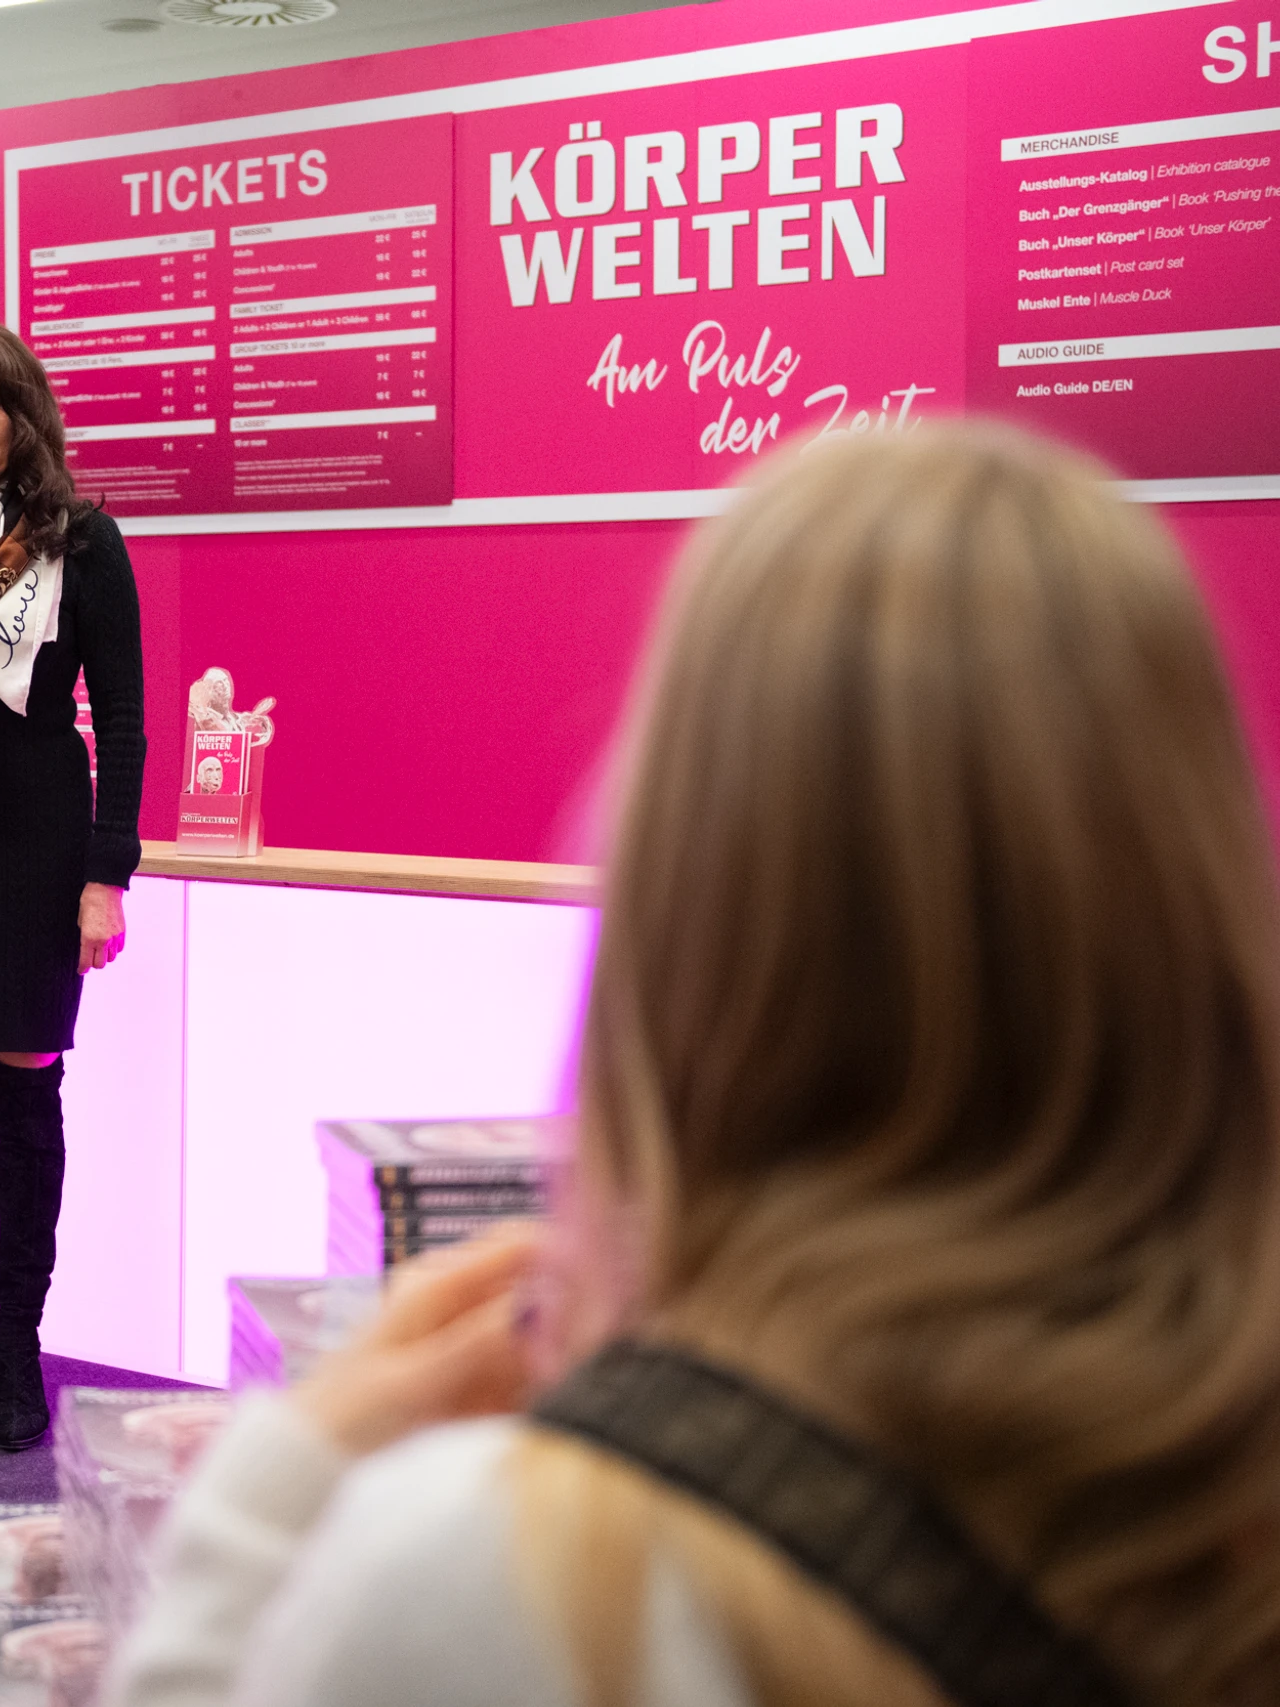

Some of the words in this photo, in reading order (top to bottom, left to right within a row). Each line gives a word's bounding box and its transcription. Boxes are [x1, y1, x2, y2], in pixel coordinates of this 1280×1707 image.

[1020, 132, 1120, 154] MERCHANDISE
[489, 102, 906, 227] KÖRPER
[1019, 168, 1149, 193] Ausstellungs-Katalog
[1157, 161, 1211, 179] Exhibition
[1214, 156, 1271, 175] catalogue
[122, 149, 328, 217] TICKETS
[1019, 207, 1050, 222] Buch
[1083, 196, 1170, 216] Grenzgänger“
[1178, 192, 1209, 207] Book
[499, 195, 886, 308] WELTEN
[1019, 238, 1050, 252] Buch
[1154, 224, 1185, 240] Book
[1018, 263, 1102, 282] Postkartenset
[1110, 257, 1136, 273] Post
[1138, 256, 1165, 272] card
[1166, 255, 1185, 270] set
[1018, 296, 1061, 312] Muskel
[1063, 294, 1091, 309] Ente
[1100, 288, 1139, 304] Muscle
[1142, 286, 1173, 302] Duck
[587, 332, 669, 408] Am
[682, 320, 801, 398] Puls
[1018, 347, 1060, 361] AUDIO
[1062, 343, 1106, 358] GUIDE
[1016, 382, 1051, 397] Audio
[1054, 379, 1089, 395] Guide
[1092, 378, 1133, 394] DE/EN
[699, 397, 781, 455] der
[800, 383, 937, 455] Zeit
[197, 735, 232, 743] KÖRPER
[198, 742, 231, 750] WELTEN
